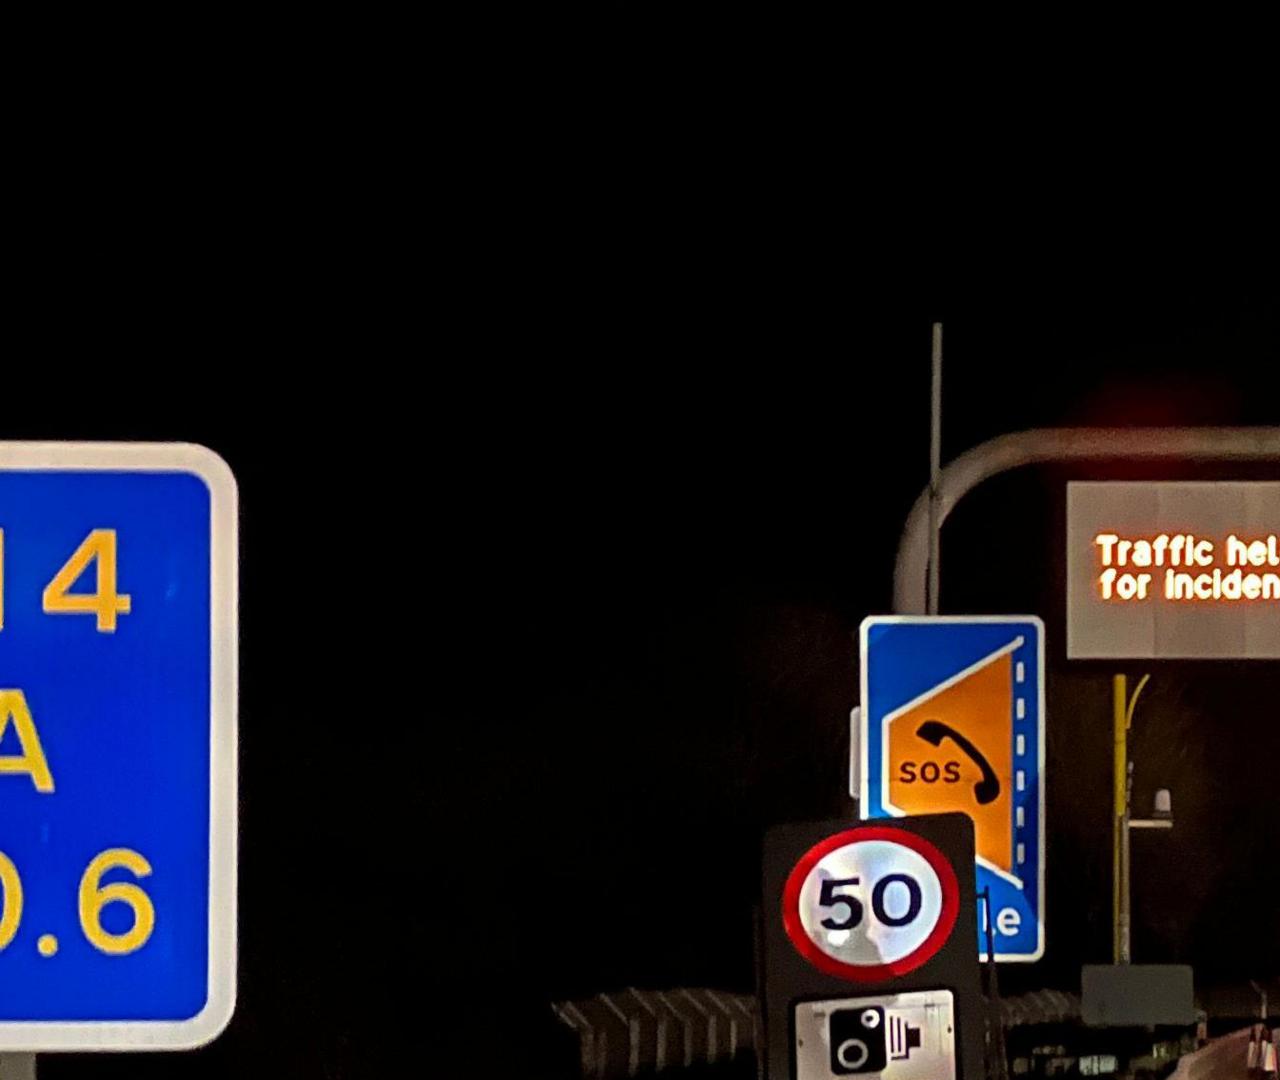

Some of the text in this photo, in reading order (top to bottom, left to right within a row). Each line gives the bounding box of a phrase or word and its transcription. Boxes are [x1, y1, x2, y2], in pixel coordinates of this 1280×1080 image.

[1096, 534, 1213, 566] Traffic
[1100, 568, 1151, 600] for
[899, 761, 961, 784] SOS
[818, 873, 922, 930] 50
